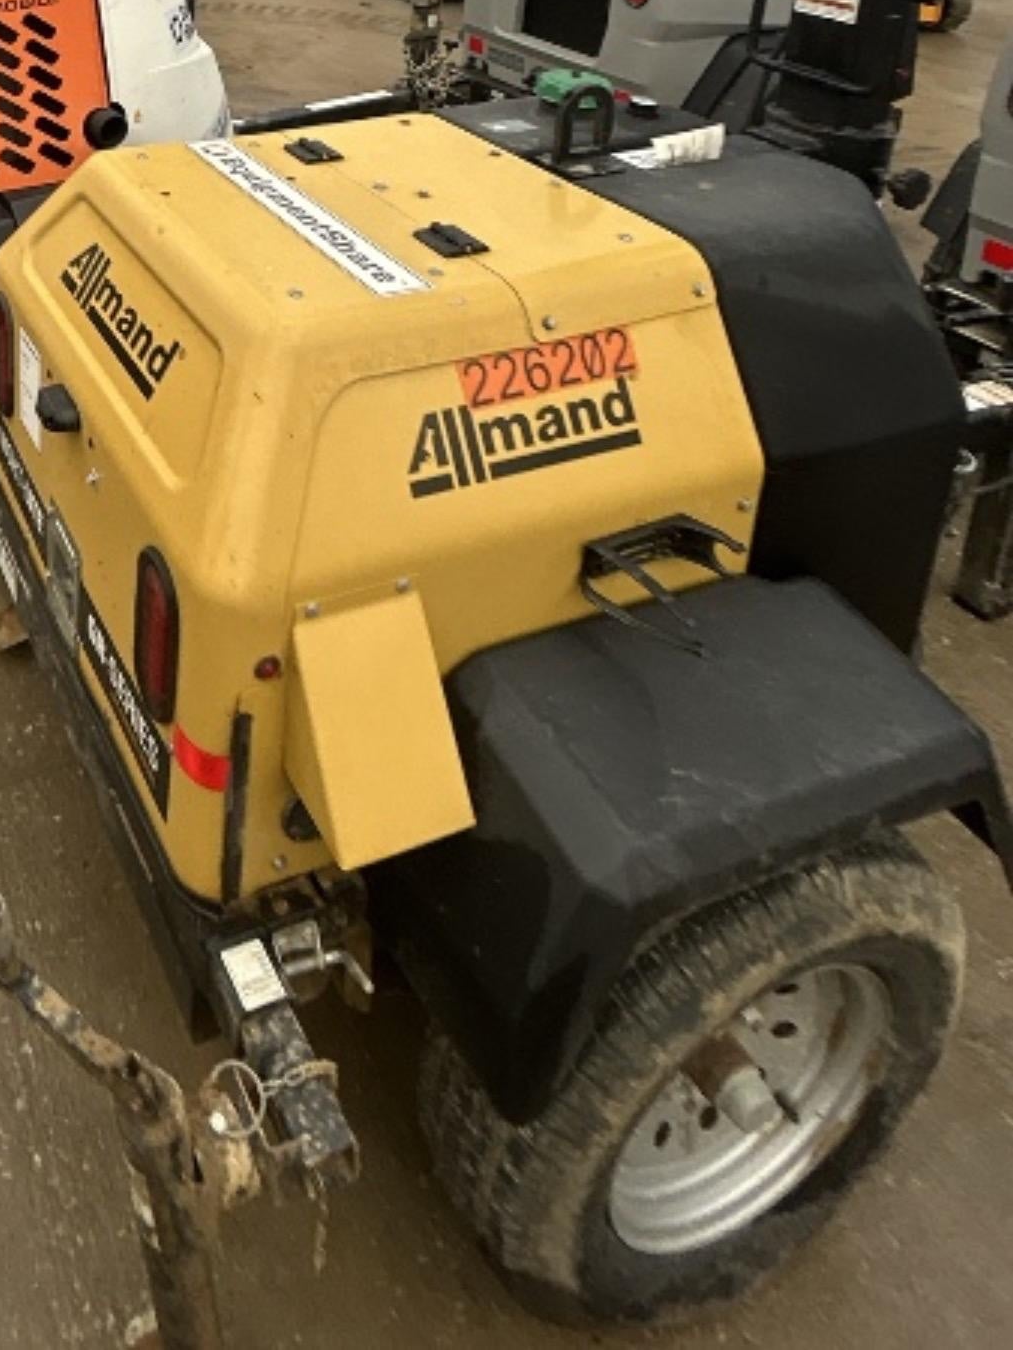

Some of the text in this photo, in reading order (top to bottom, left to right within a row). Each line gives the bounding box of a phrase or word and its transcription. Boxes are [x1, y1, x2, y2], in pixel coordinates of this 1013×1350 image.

[64, 242, 181, 388] Allmand
[462, 328, 637, 409] 226202
[406, 375, 640, 492] Allmand
